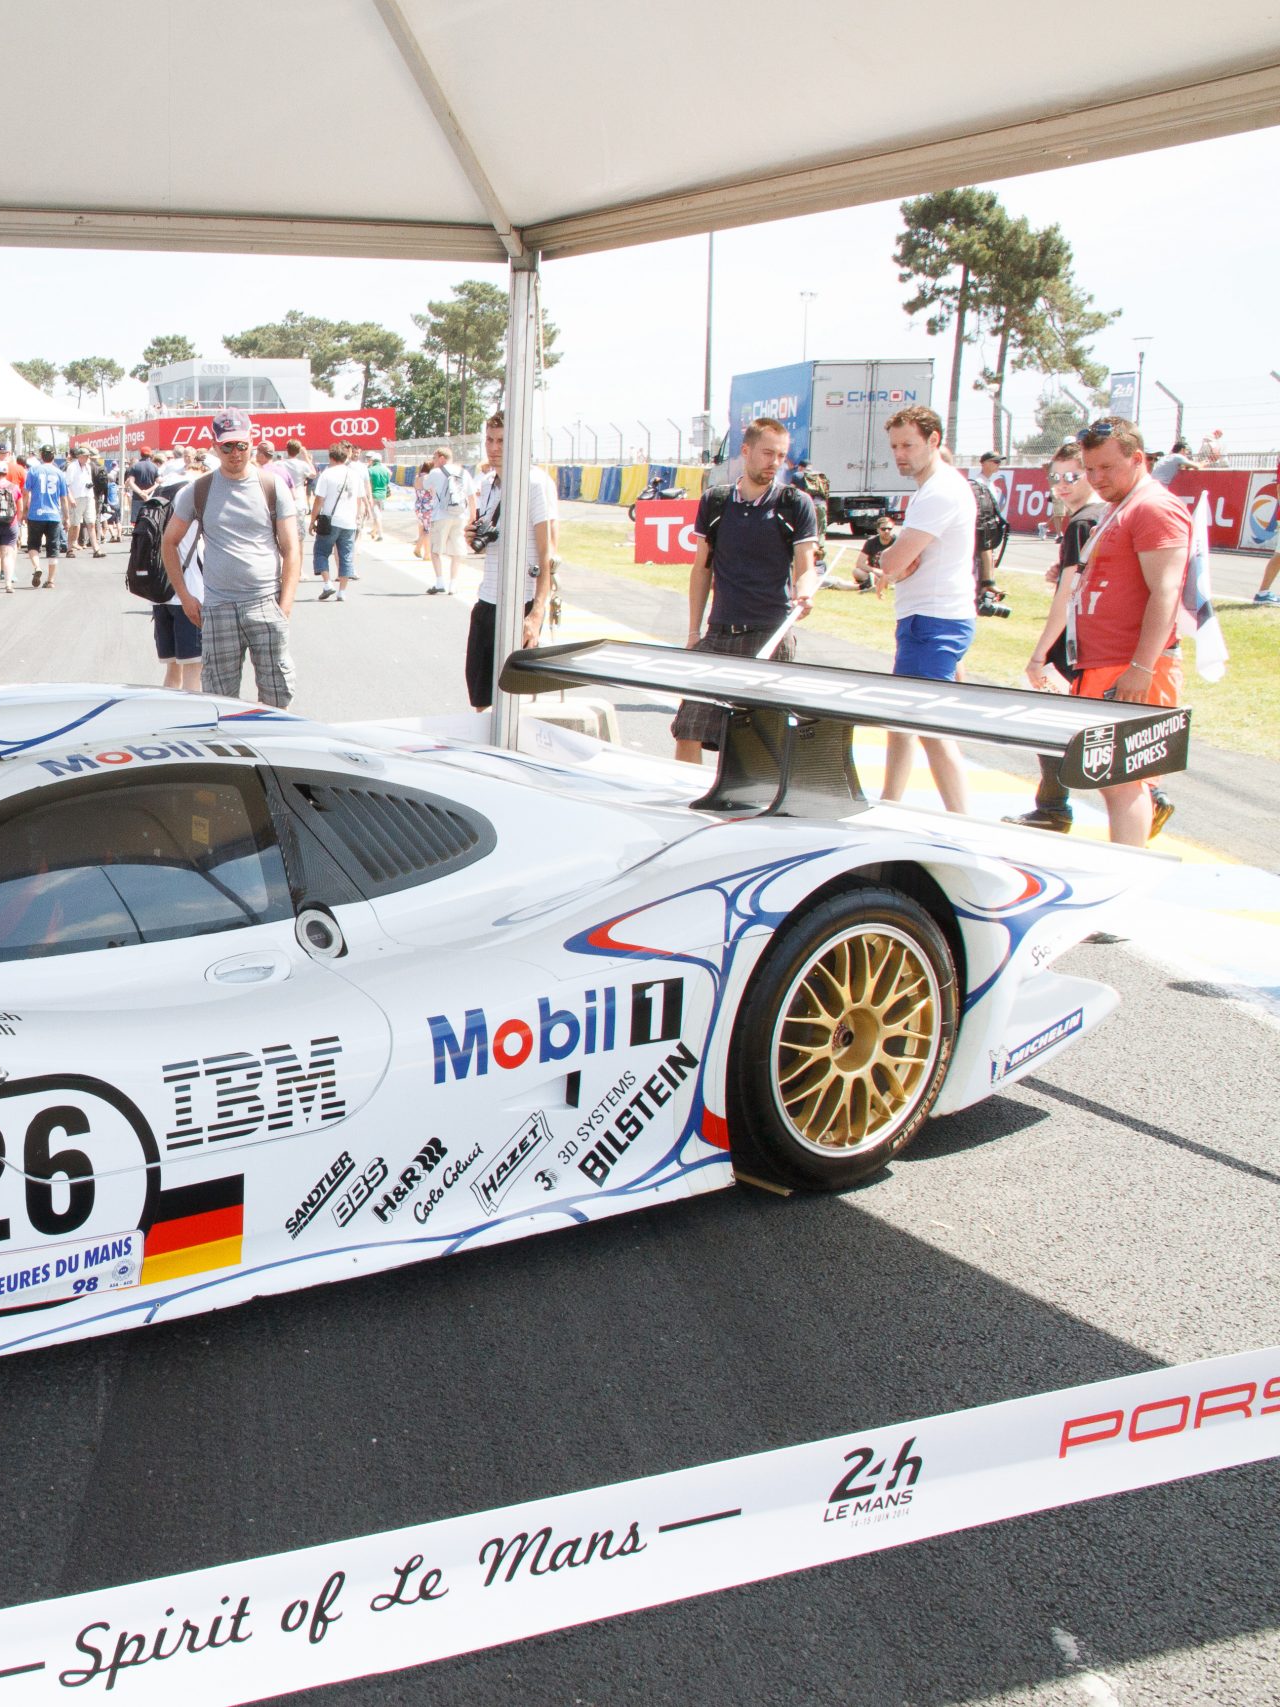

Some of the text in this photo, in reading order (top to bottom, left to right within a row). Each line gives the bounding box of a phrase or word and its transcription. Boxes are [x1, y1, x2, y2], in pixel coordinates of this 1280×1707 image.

[251, 422, 306, 442] Sport
[39, 473, 57, 494] 13
[573, 650, 1100, 726] PORSCHE
[36, 740, 205, 777] Mobil
[1083, 745, 1112, 773] ups
[1124, 712, 1186, 753] WORLDWIDE
[1125, 740, 1167, 774] EXPRESS
[426, 985, 617, 1085] Mobil
[1009, 1012, 1082, 1067] MICHELIN
[162, 1035, 346, 1150] IBM
[557, 1070, 637, 1165] 3D SYSTEMS
[577, 1040, 700, 1188] BILSTEIN
[285, 1150, 354, 1234] SANDTLER
[480, 1123, 543, 1203] HAZET
[331, 1157, 389, 1228] BBS
[372, 1163, 423, 1224] H&R
[55, 1254, 80, 1279] DU
[83, 1235, 133, 1269] MANS
[72, 1276, 99, 1295] 98
[823, 1489, 914, 1523] LE MANS
[58, 1514, 649, 1691] Spirit of Le Mans
